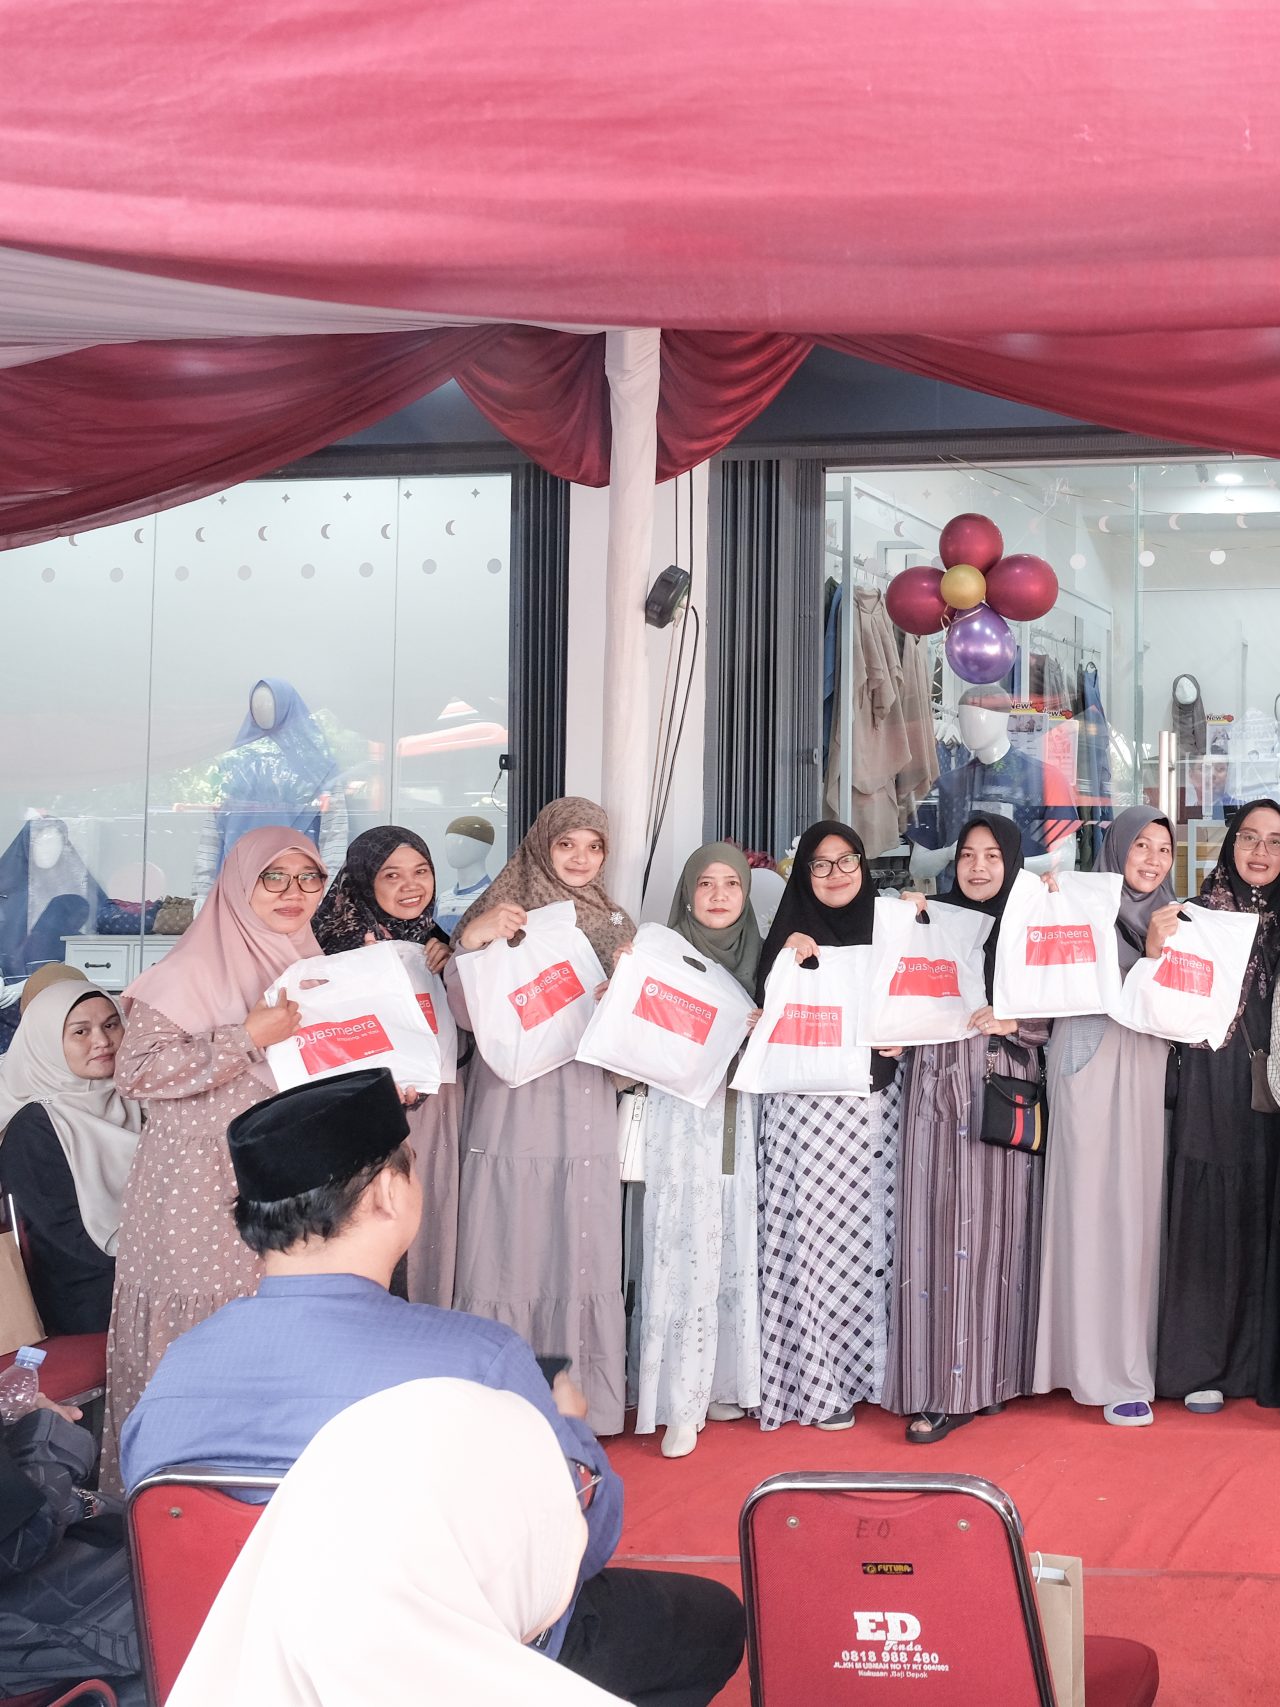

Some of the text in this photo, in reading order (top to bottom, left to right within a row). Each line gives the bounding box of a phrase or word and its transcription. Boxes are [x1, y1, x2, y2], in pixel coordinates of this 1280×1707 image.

[659, 990, 712, 1019] yasmeera
[787, 1009, 838, 1020] yasmeera
[307, 1020, 376, 1044] yasmeera
[854, 1611, 921, 1641] ED
[883, 1640, 923, 1652] Tenda
[841, 1650, 939, 1664] 0818 988 480
